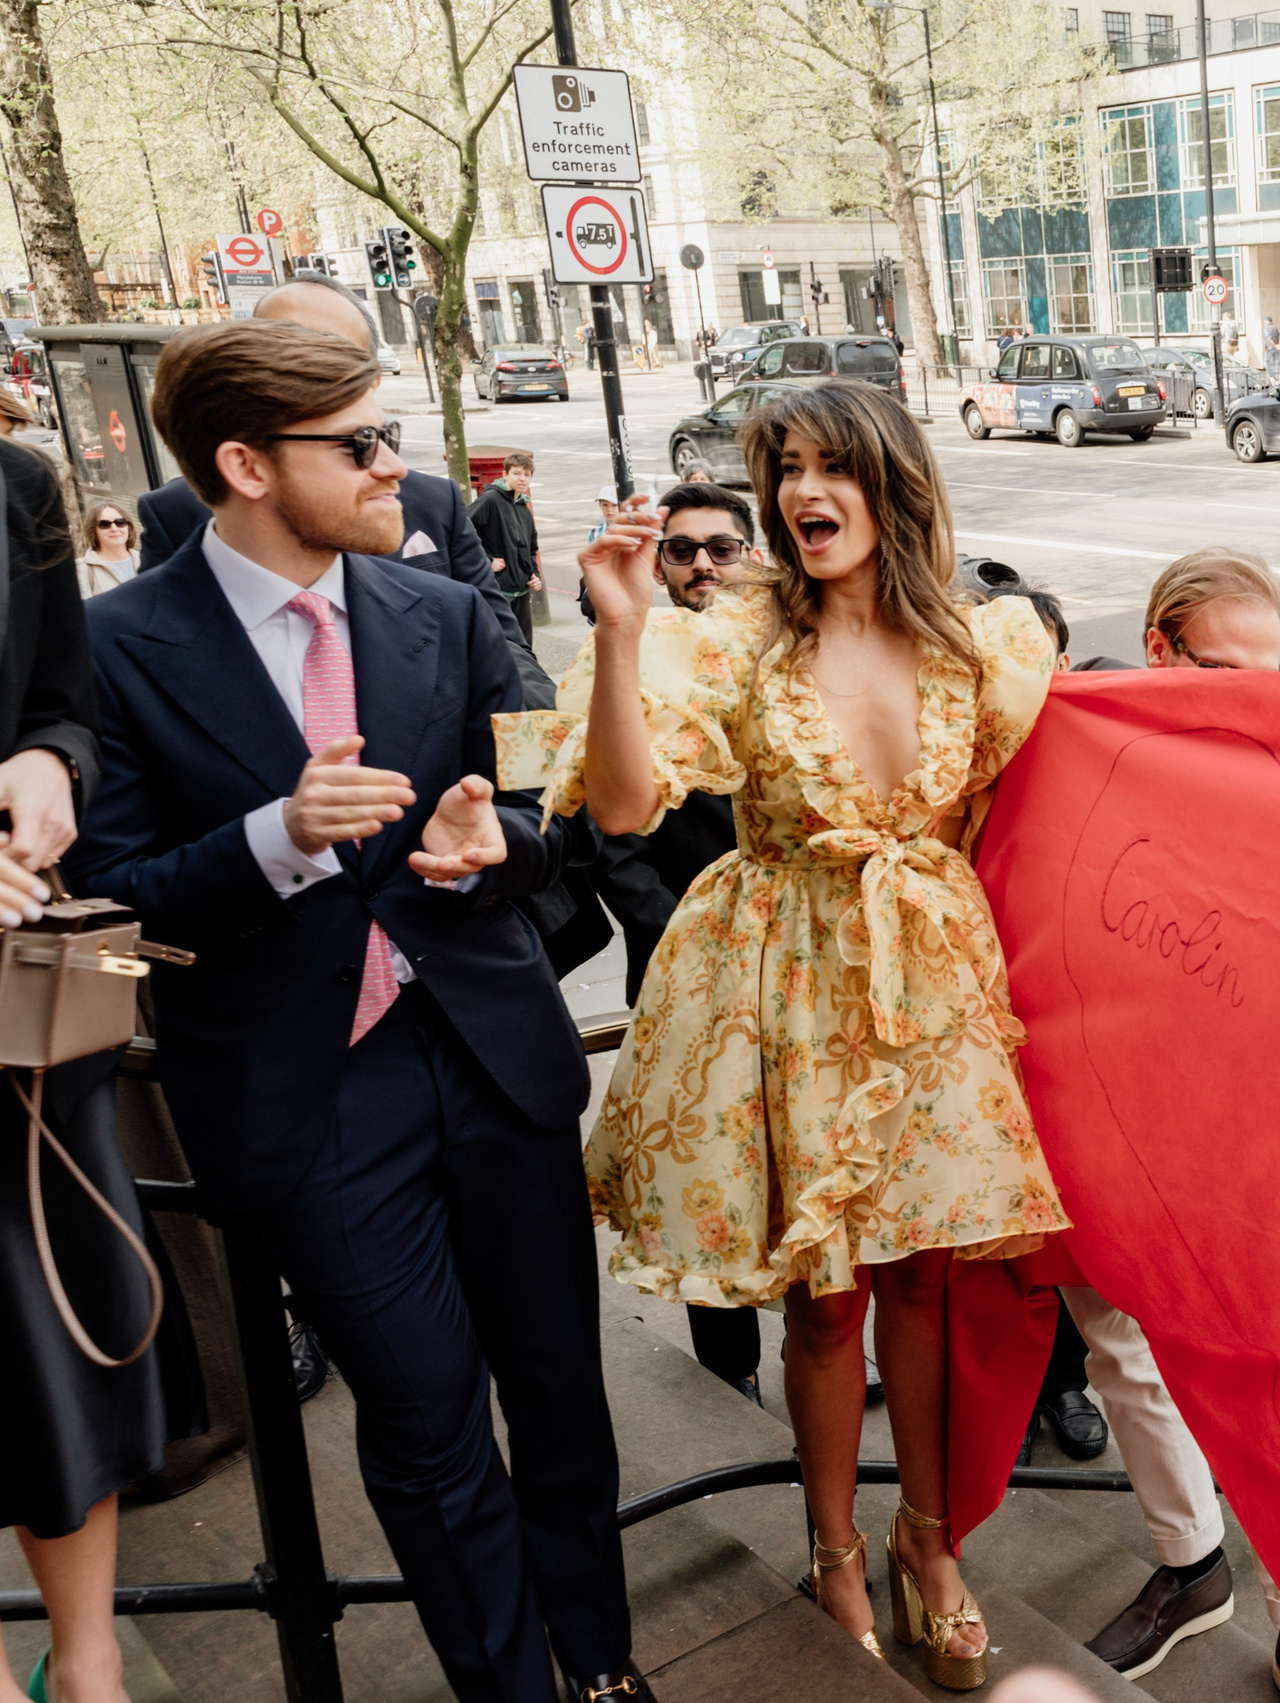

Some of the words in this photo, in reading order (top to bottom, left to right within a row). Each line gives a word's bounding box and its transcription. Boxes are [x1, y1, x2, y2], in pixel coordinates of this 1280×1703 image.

[553, 121, 605, 137] Traffic
[532, 140, 631, 155] enforcement
[552, 161, 617, 172] cameras
[262, 212, 277, 230] P
[587, 225, 613, 240] 7.5T
[1208, 284, 1225, 296] 20
[1101, 836, 1244, 1008] Carolin
